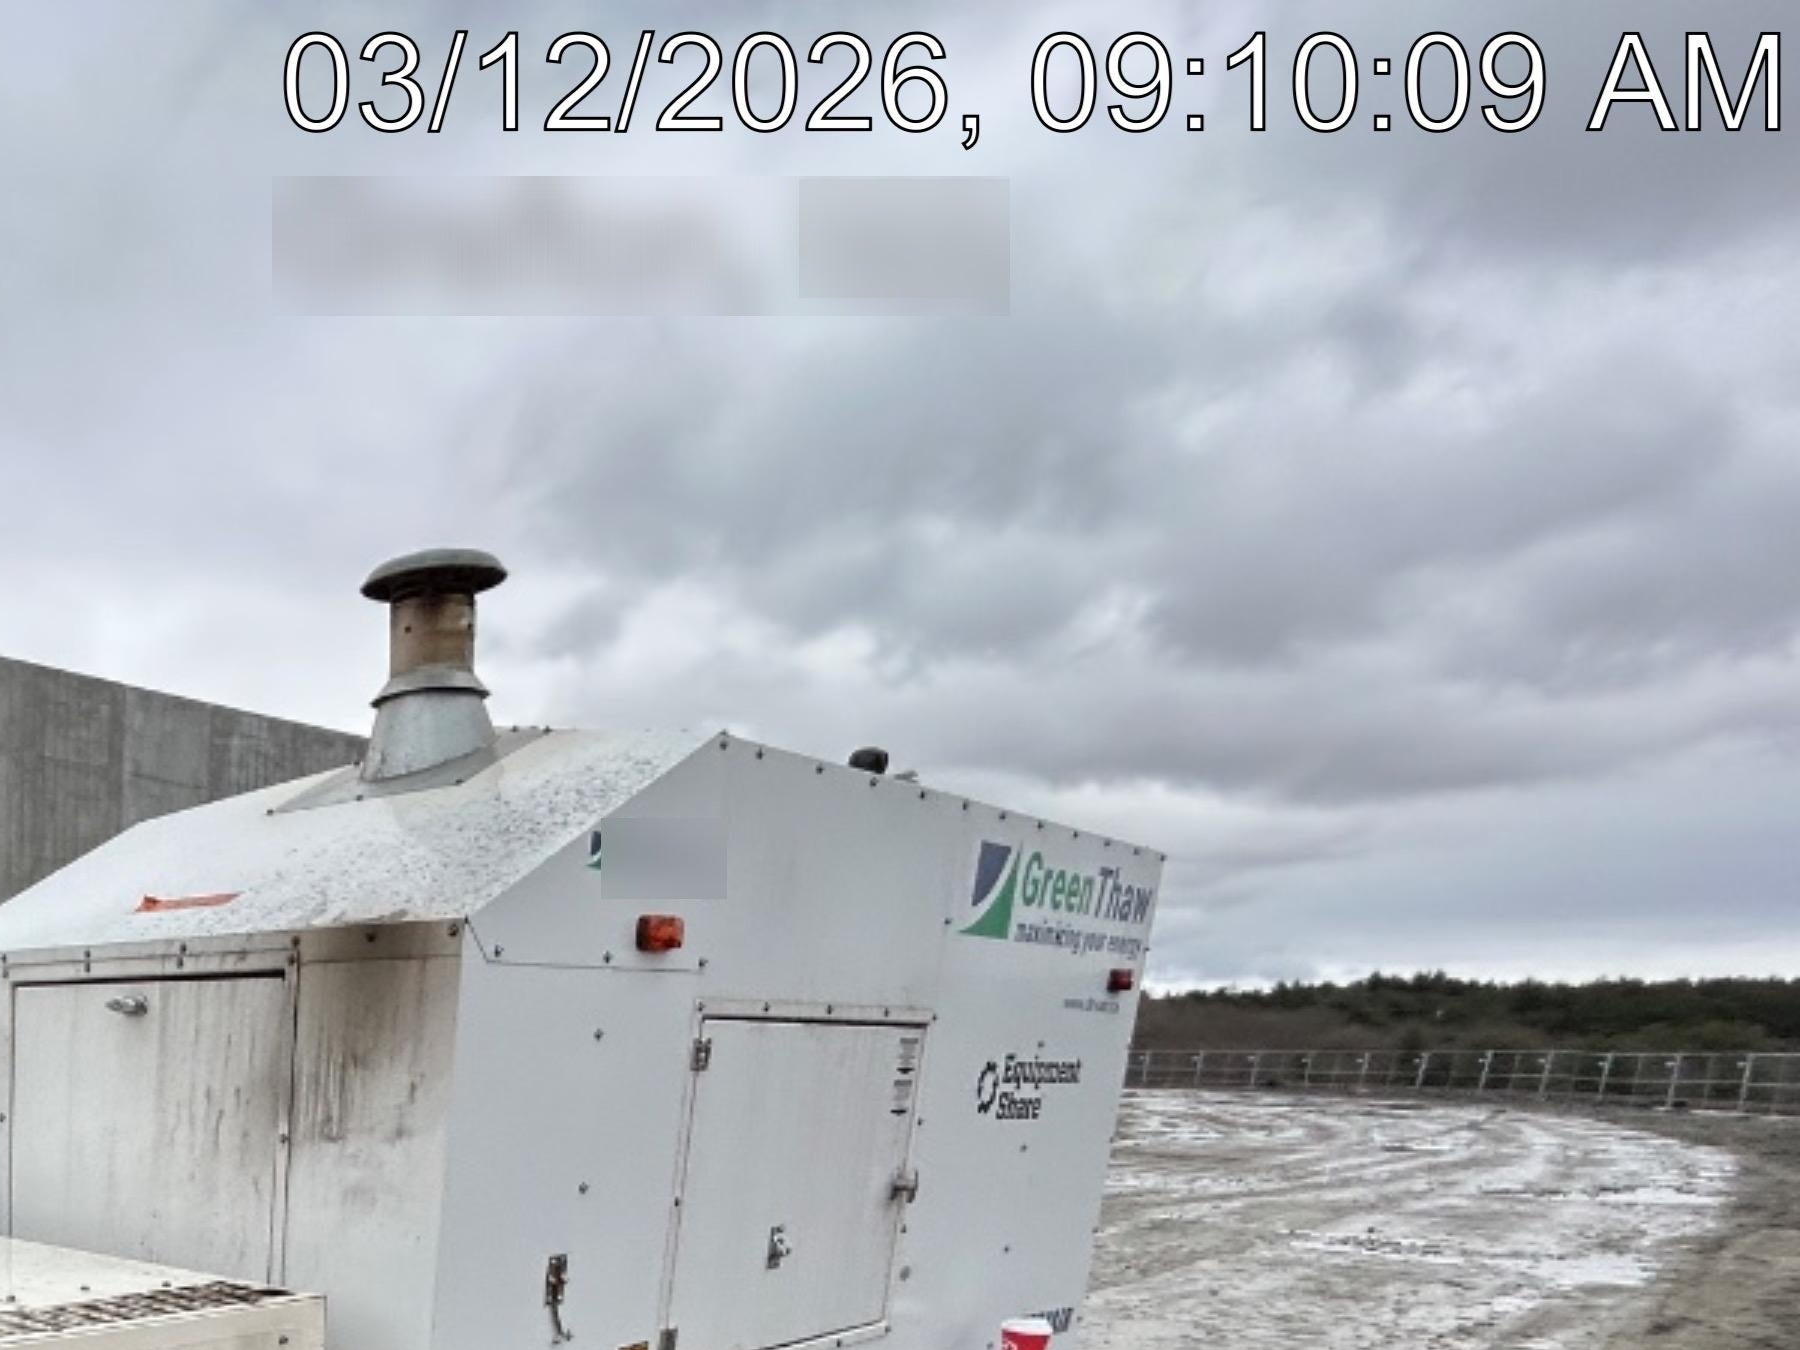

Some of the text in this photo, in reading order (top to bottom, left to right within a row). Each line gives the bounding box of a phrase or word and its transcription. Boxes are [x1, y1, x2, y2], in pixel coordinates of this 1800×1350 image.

[1080, 932, 1108, 957] your
[1002, 1053, 1081, 1090] Equipment
[996, 1091, 1042, 1120] Share
